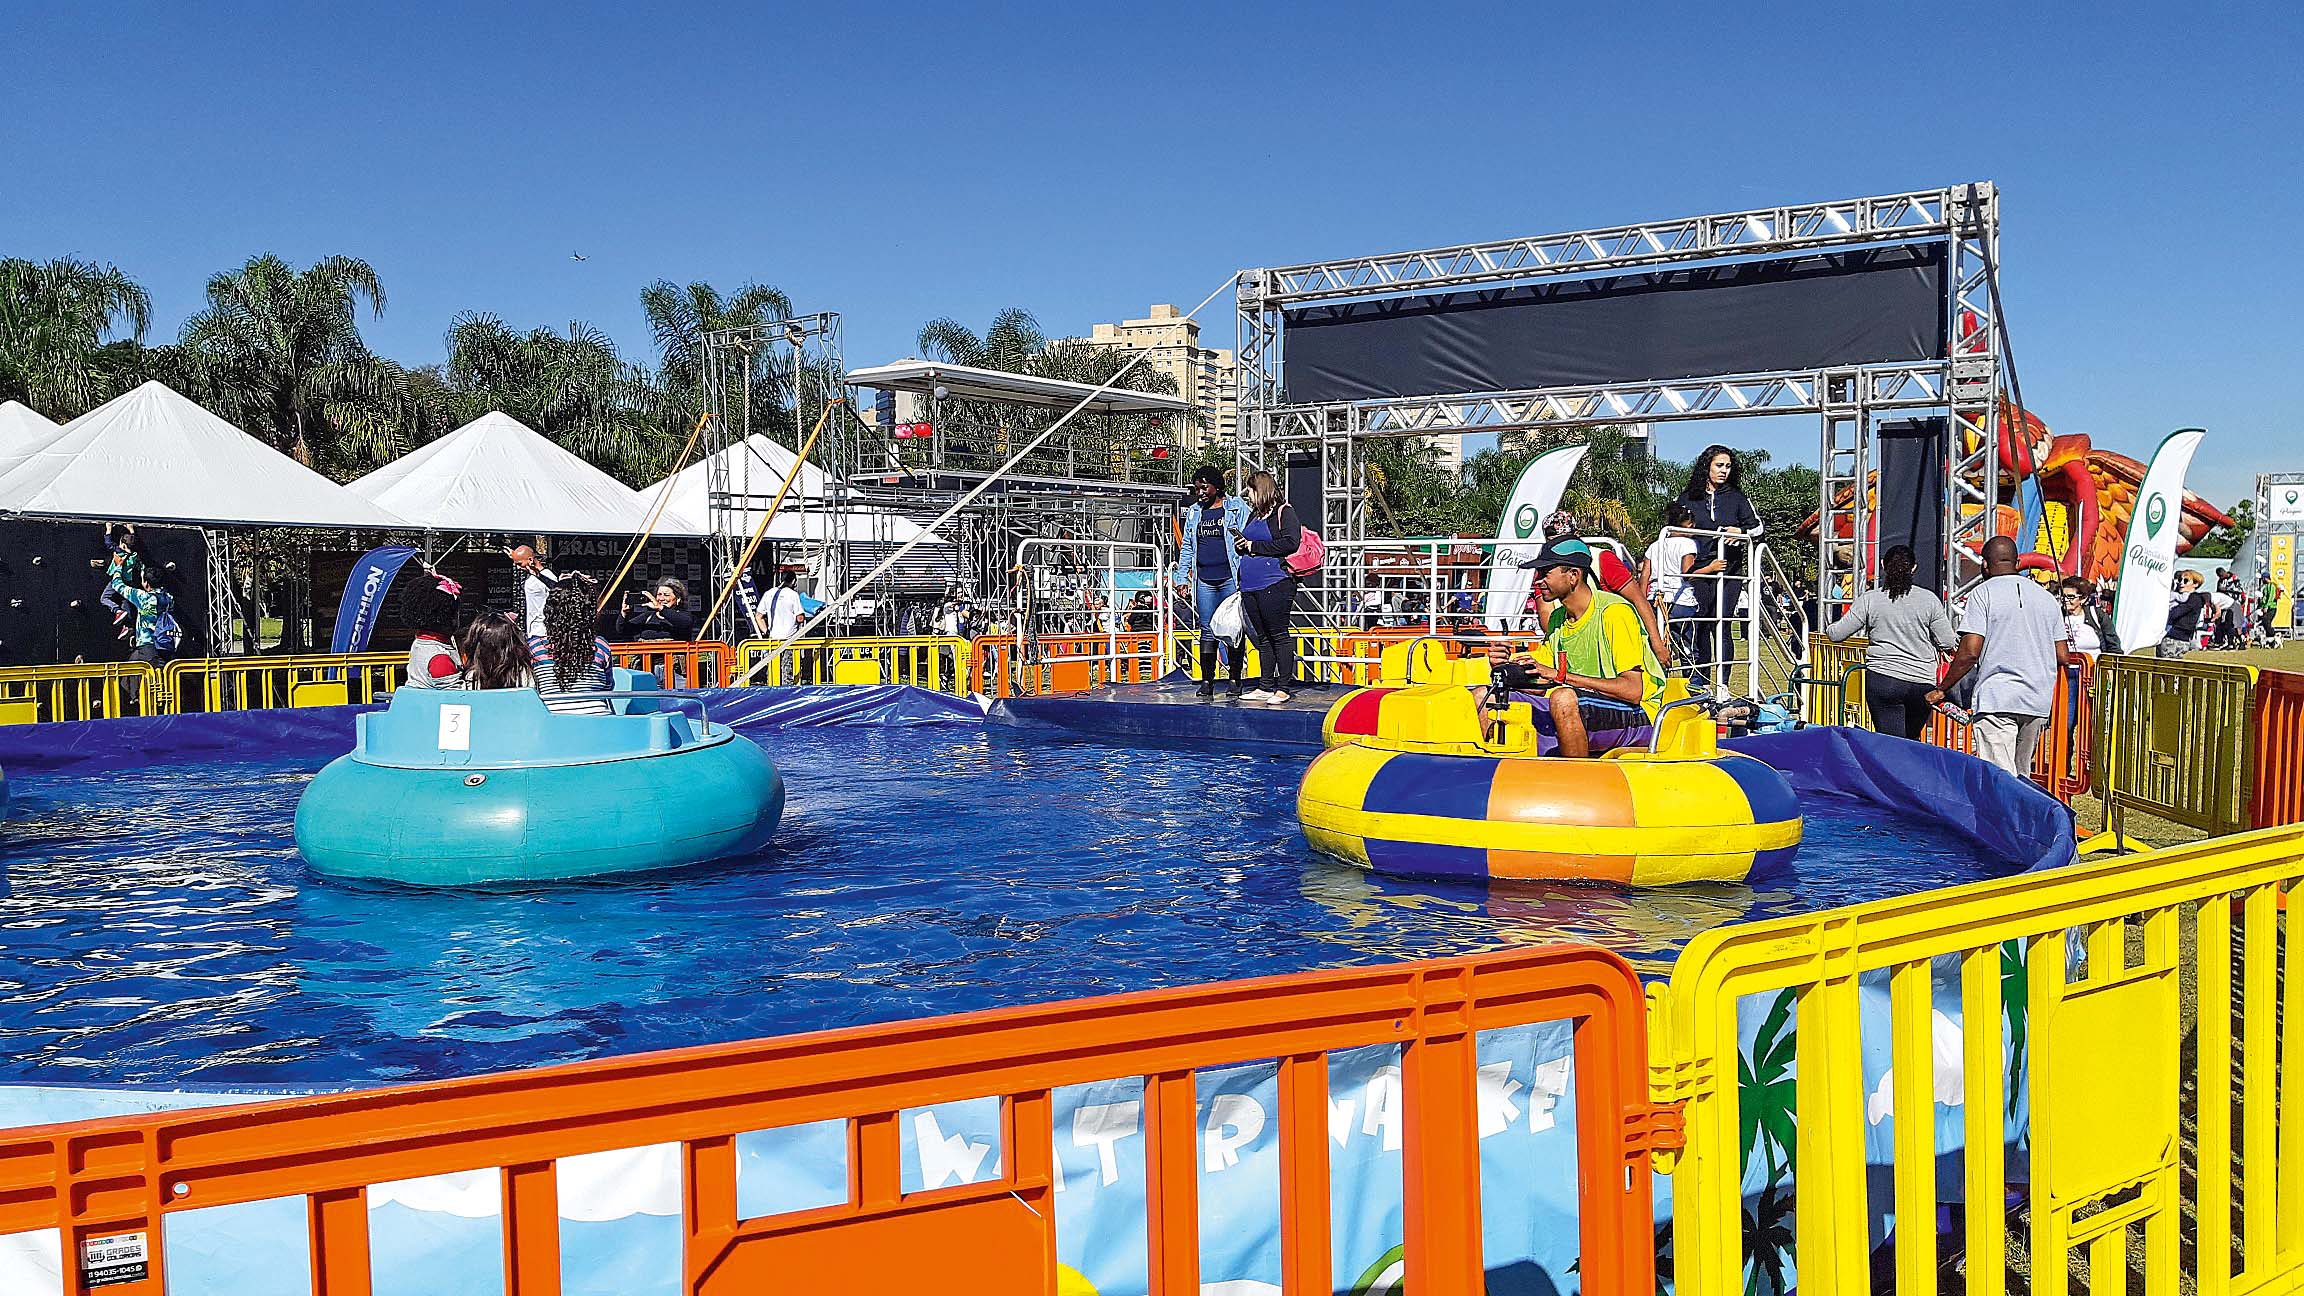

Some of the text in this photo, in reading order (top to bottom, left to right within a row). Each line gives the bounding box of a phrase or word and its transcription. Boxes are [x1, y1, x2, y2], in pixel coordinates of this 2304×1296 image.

[559, 540, 624, 556] BRASIL
[2129, 545, 2168, 577] Parque
[349, 565, 384, 652] ECATHLON
[450, 713, 461, 733] 3
[914, 1093, 1267, 1192] WTR
[106, 1245, 142, 1256] GRADES
[94, 1265, 136, 1278] 94035-1045
